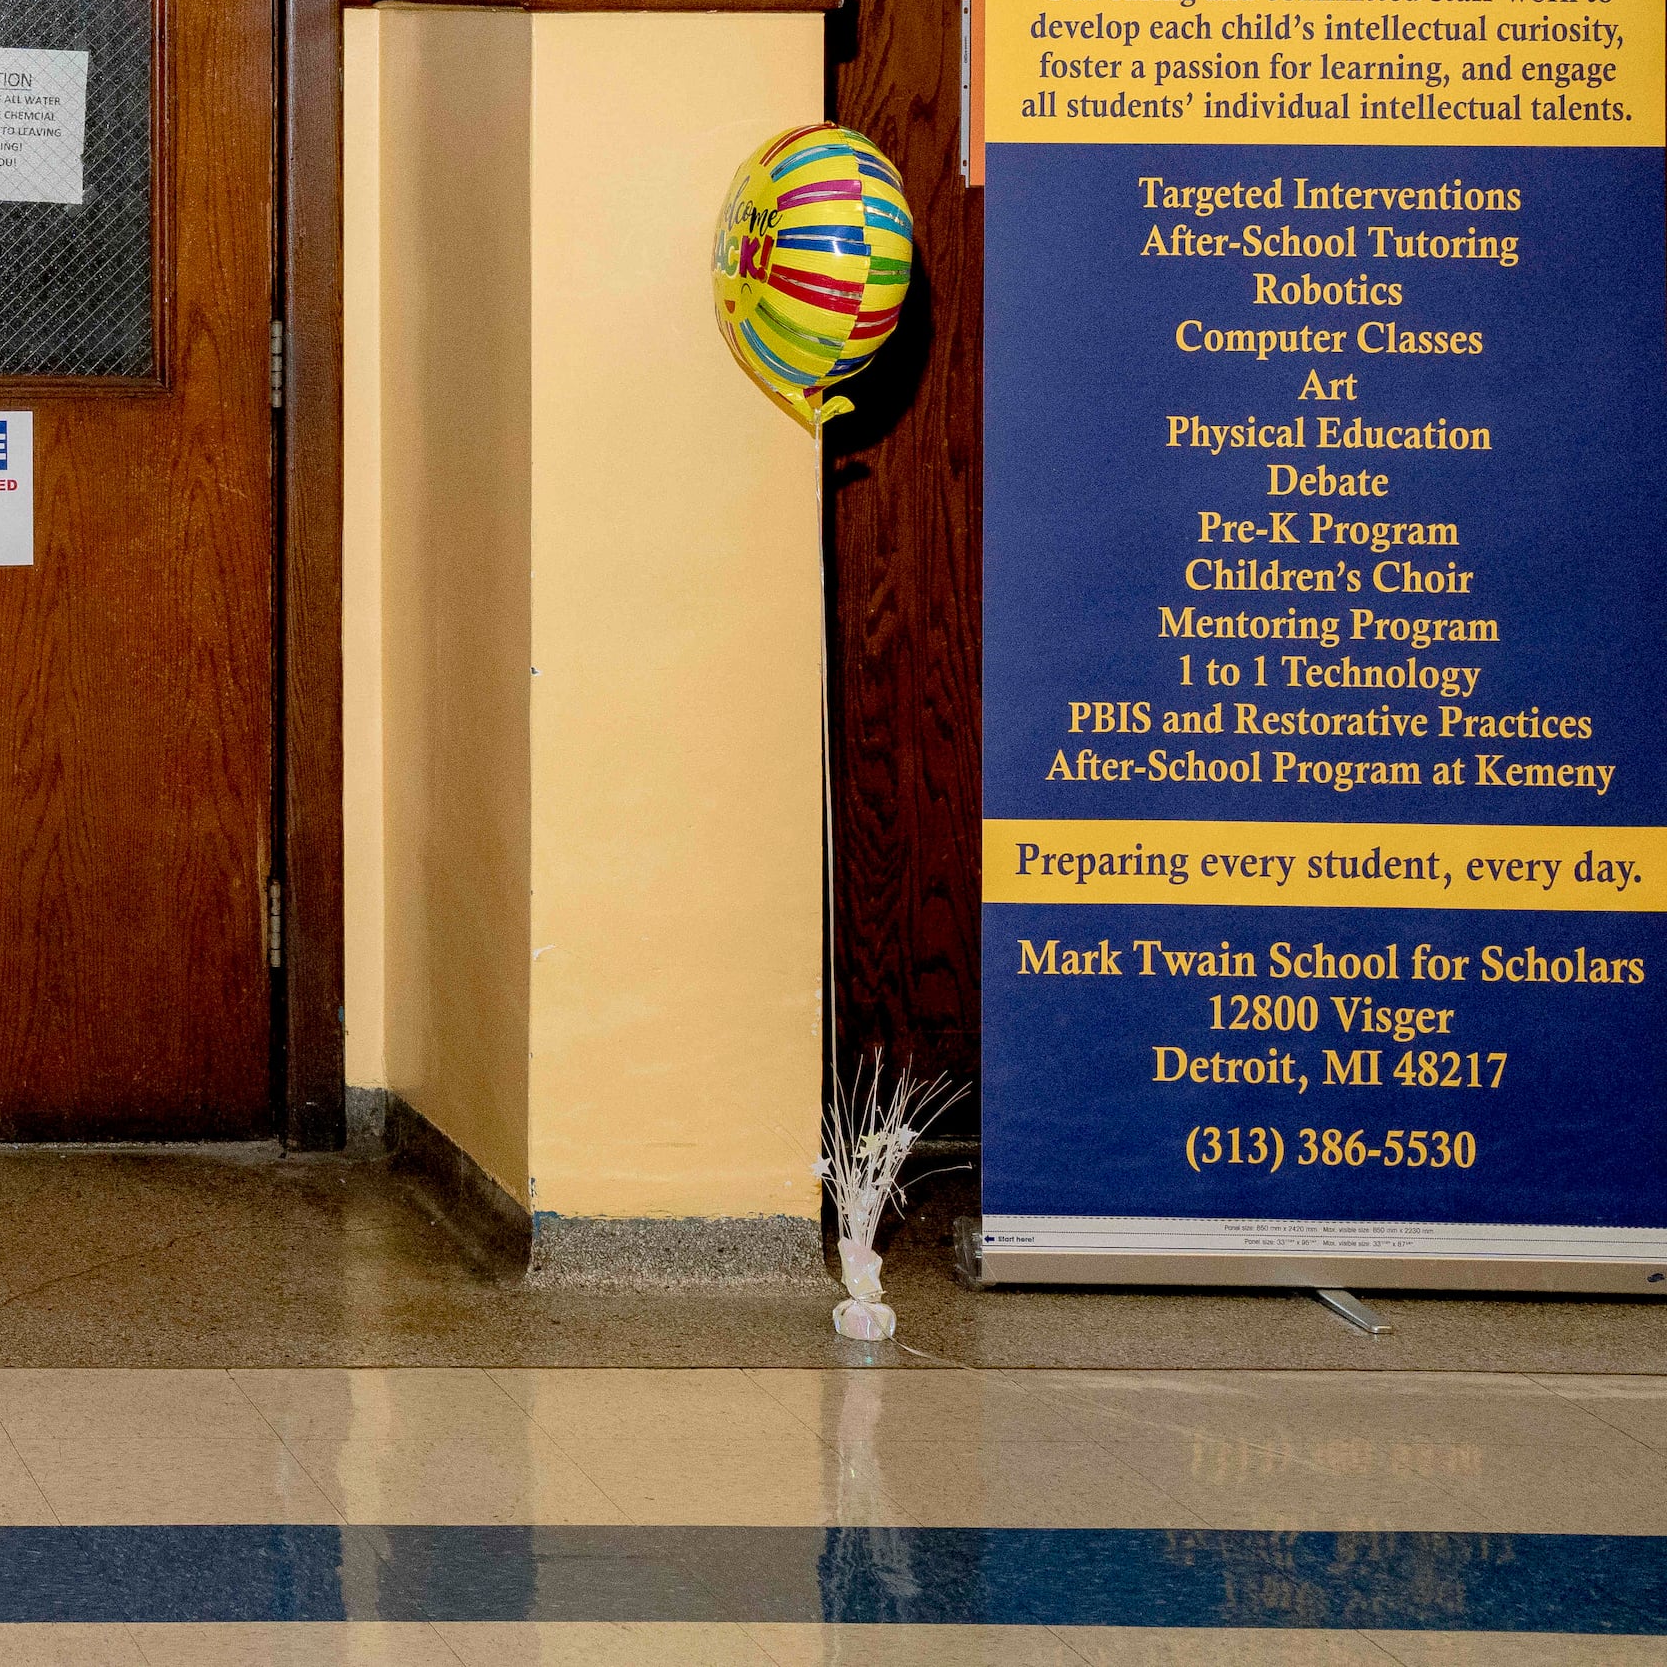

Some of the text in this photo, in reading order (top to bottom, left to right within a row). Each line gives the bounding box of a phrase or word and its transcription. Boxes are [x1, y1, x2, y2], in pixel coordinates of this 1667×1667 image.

[4, 111, 56, 121] CHEMCIAL
[5, 95, 21, 104] ALL
[25, 96, 61, 105] WATER
[2, 127, 15, 135] TO
[18, 127, 62, 137] LEAVING
[724, 176, 782, 236] elcome
[1139, 177, 1521, 217] Targeted Interventions
[712, 230, 774, 283] ACK!
[1141, 224, 1519, 267] After-School Tutoring
[1253, 273, 1402, 305] Robotics
[1176, 320, 1483, 360] Computer Classes
[1298, 369, 1357, 400] Art
[1166, 416, 1492, 455] Physical Education
[1267, 464, 1388, 497] Debate
[1198, 512, 1459, 553] Pre-K Program
[1373, 561, 1473, 593] Choir
[1158, 607, 1500, 649] Mentoring Program
[1180, 654, 1481, 697] 1 to 1 Technology
[1068, 702, 1592, 739] PBIS and Restorative Practices
[1045, 749, 1615, 795] After-School Program at Kemeny
[1017, 939, 1644, 984] Mark Twain School for Scholars
[1210, 995, 1454, 1042] 12800 Visger
[1152, 1047, 1507, 1094] Detroit, MI 48217
[1186, 1126, 1476, 1173] (313) 386-5530
